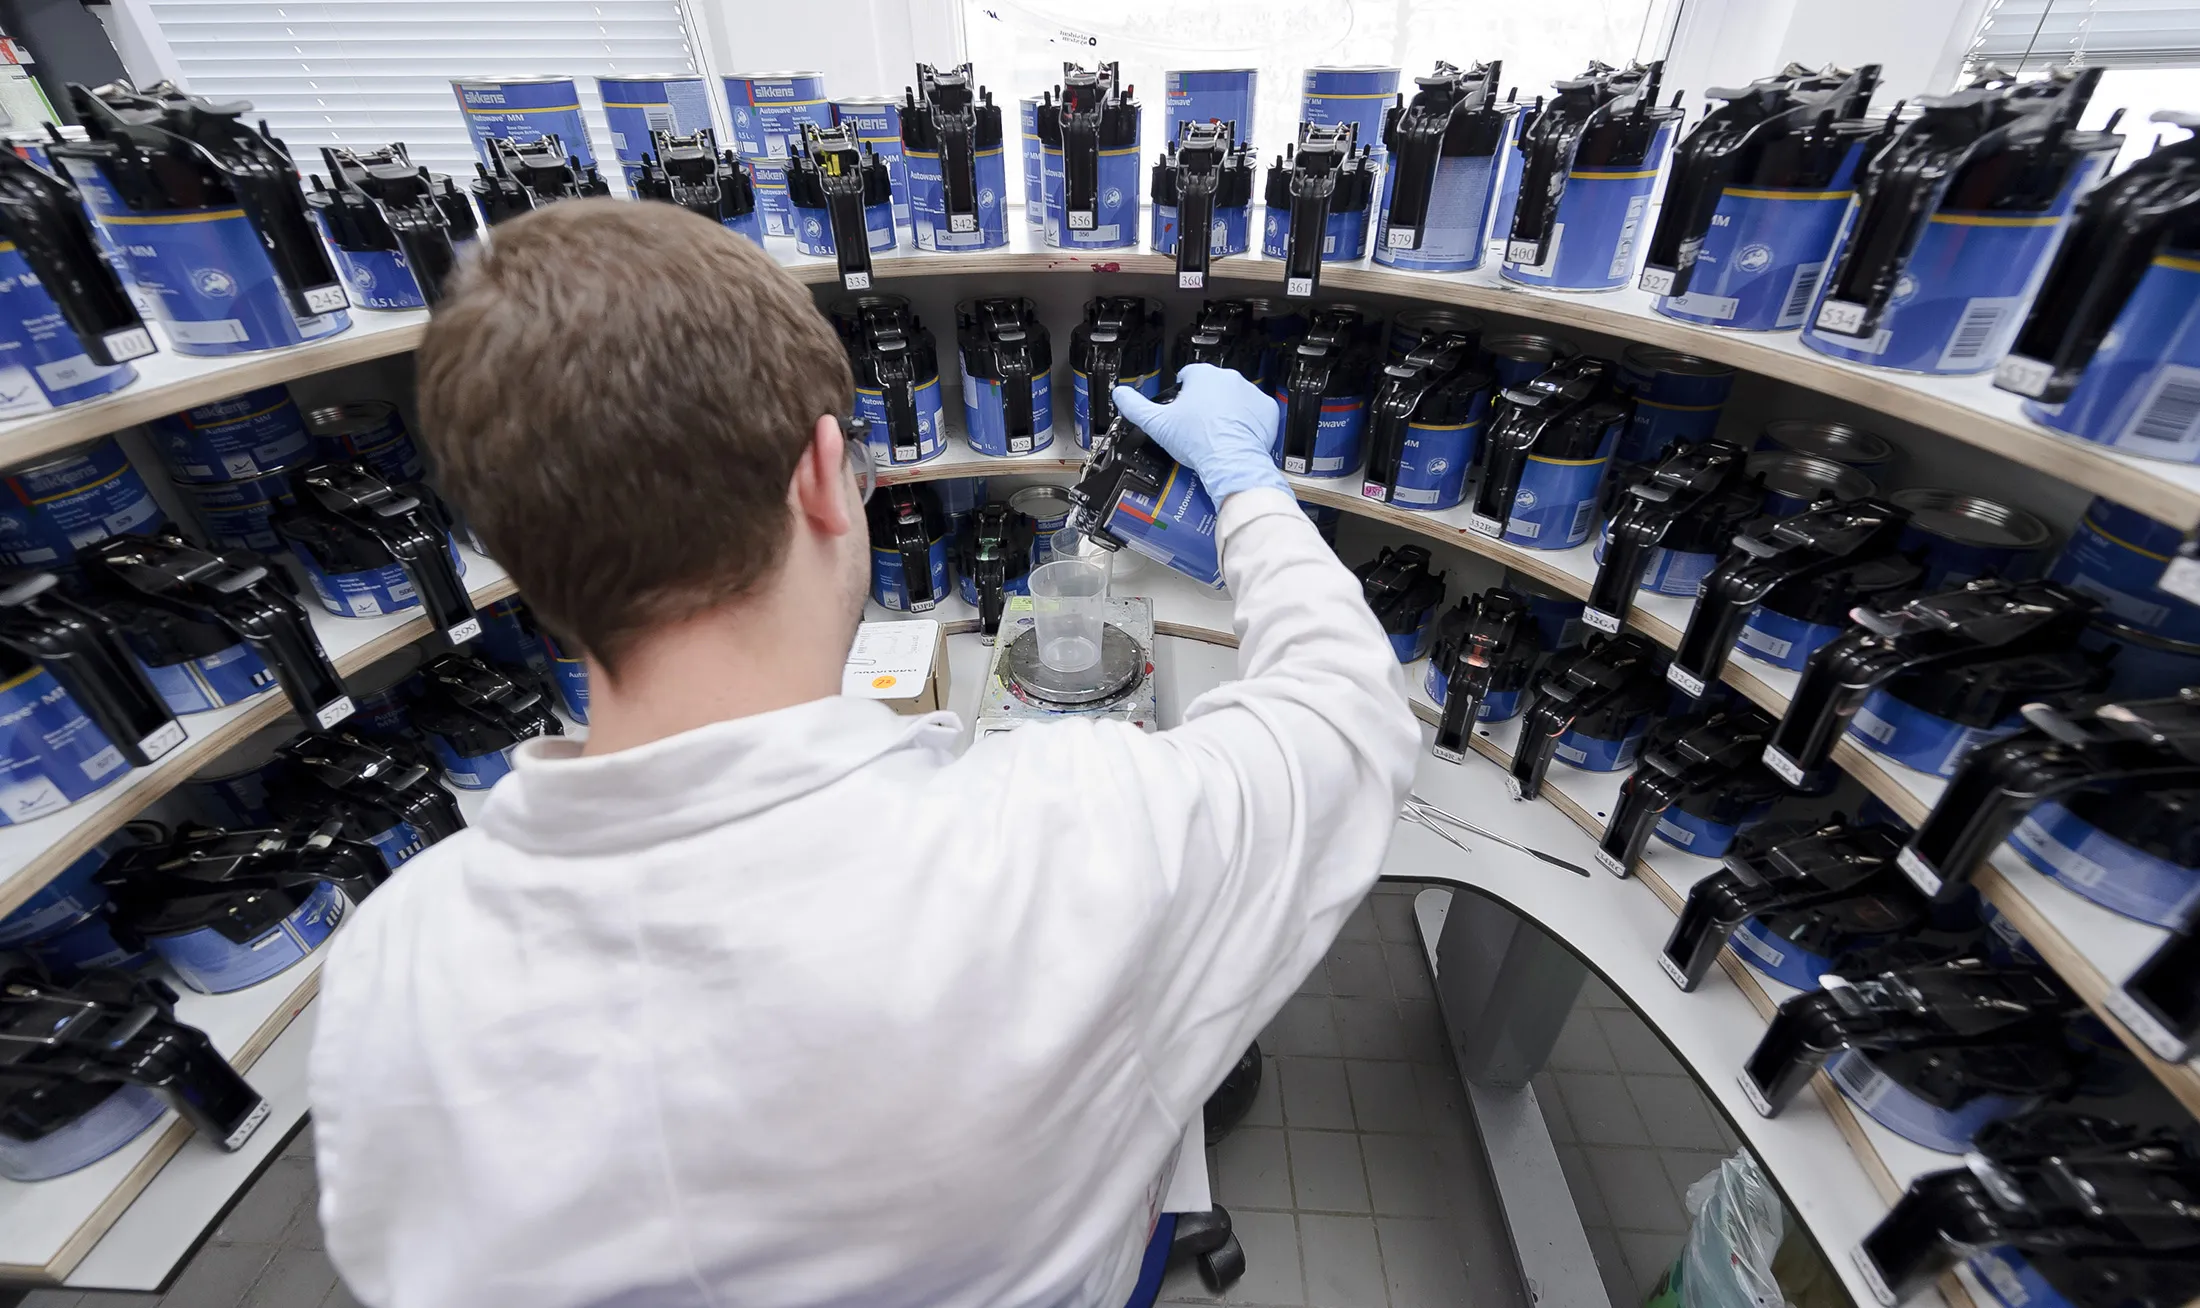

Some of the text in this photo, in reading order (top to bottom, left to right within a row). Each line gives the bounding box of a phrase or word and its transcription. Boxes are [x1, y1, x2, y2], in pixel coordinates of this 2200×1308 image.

[464, 91, 506, 104] sikkens
[755, 86, 795, 97] sikkens
[472, 114, 525, 122] Autowave MM
[756, 170, 785, 181] sikken
[953, 219, 972, 229] 342
[1071, 216, 1091, 226] 356
[1390, 233, 1412, 246] 379
[1510, 247, 1535, 261] 400
[847, 276, 867, 288] 335
[1181, 275, 1201, 286] 360
[1289, 281, 1311, 293] 361
[1642, 274, 1669, 292] 527
[311, 290, 342, 308] 245
[1819, 308, 1857, 328] 534
[111, 334, 146, 357] 101
[192, 400, 251, 420] sikkens
[1317, 419, 1347, 428] owave
[1012, 439, 1030, 449] 952
[897, 449, 915, 458] 777
[1287, 460, 1304, 470] 974
[29, 464, 99, 492] sikkens
[47, 488, 101, 510] Autowave
[103, 477, 122, 491] MM
[1365, 485, 1384, 498] 980
[1173, 480, 1198, 523] Autowave
[1469, 519, 1500, 534] 332B
[878, 559, 903, 567] Autowav
[1583, 611, 1616, 631] 332GA
[454, 623, 477, 641] 599
[1668, 667, 1702, 693] 332GB
[323, 702, 349, 725] 579
[147, 727, 178, 756] 577
